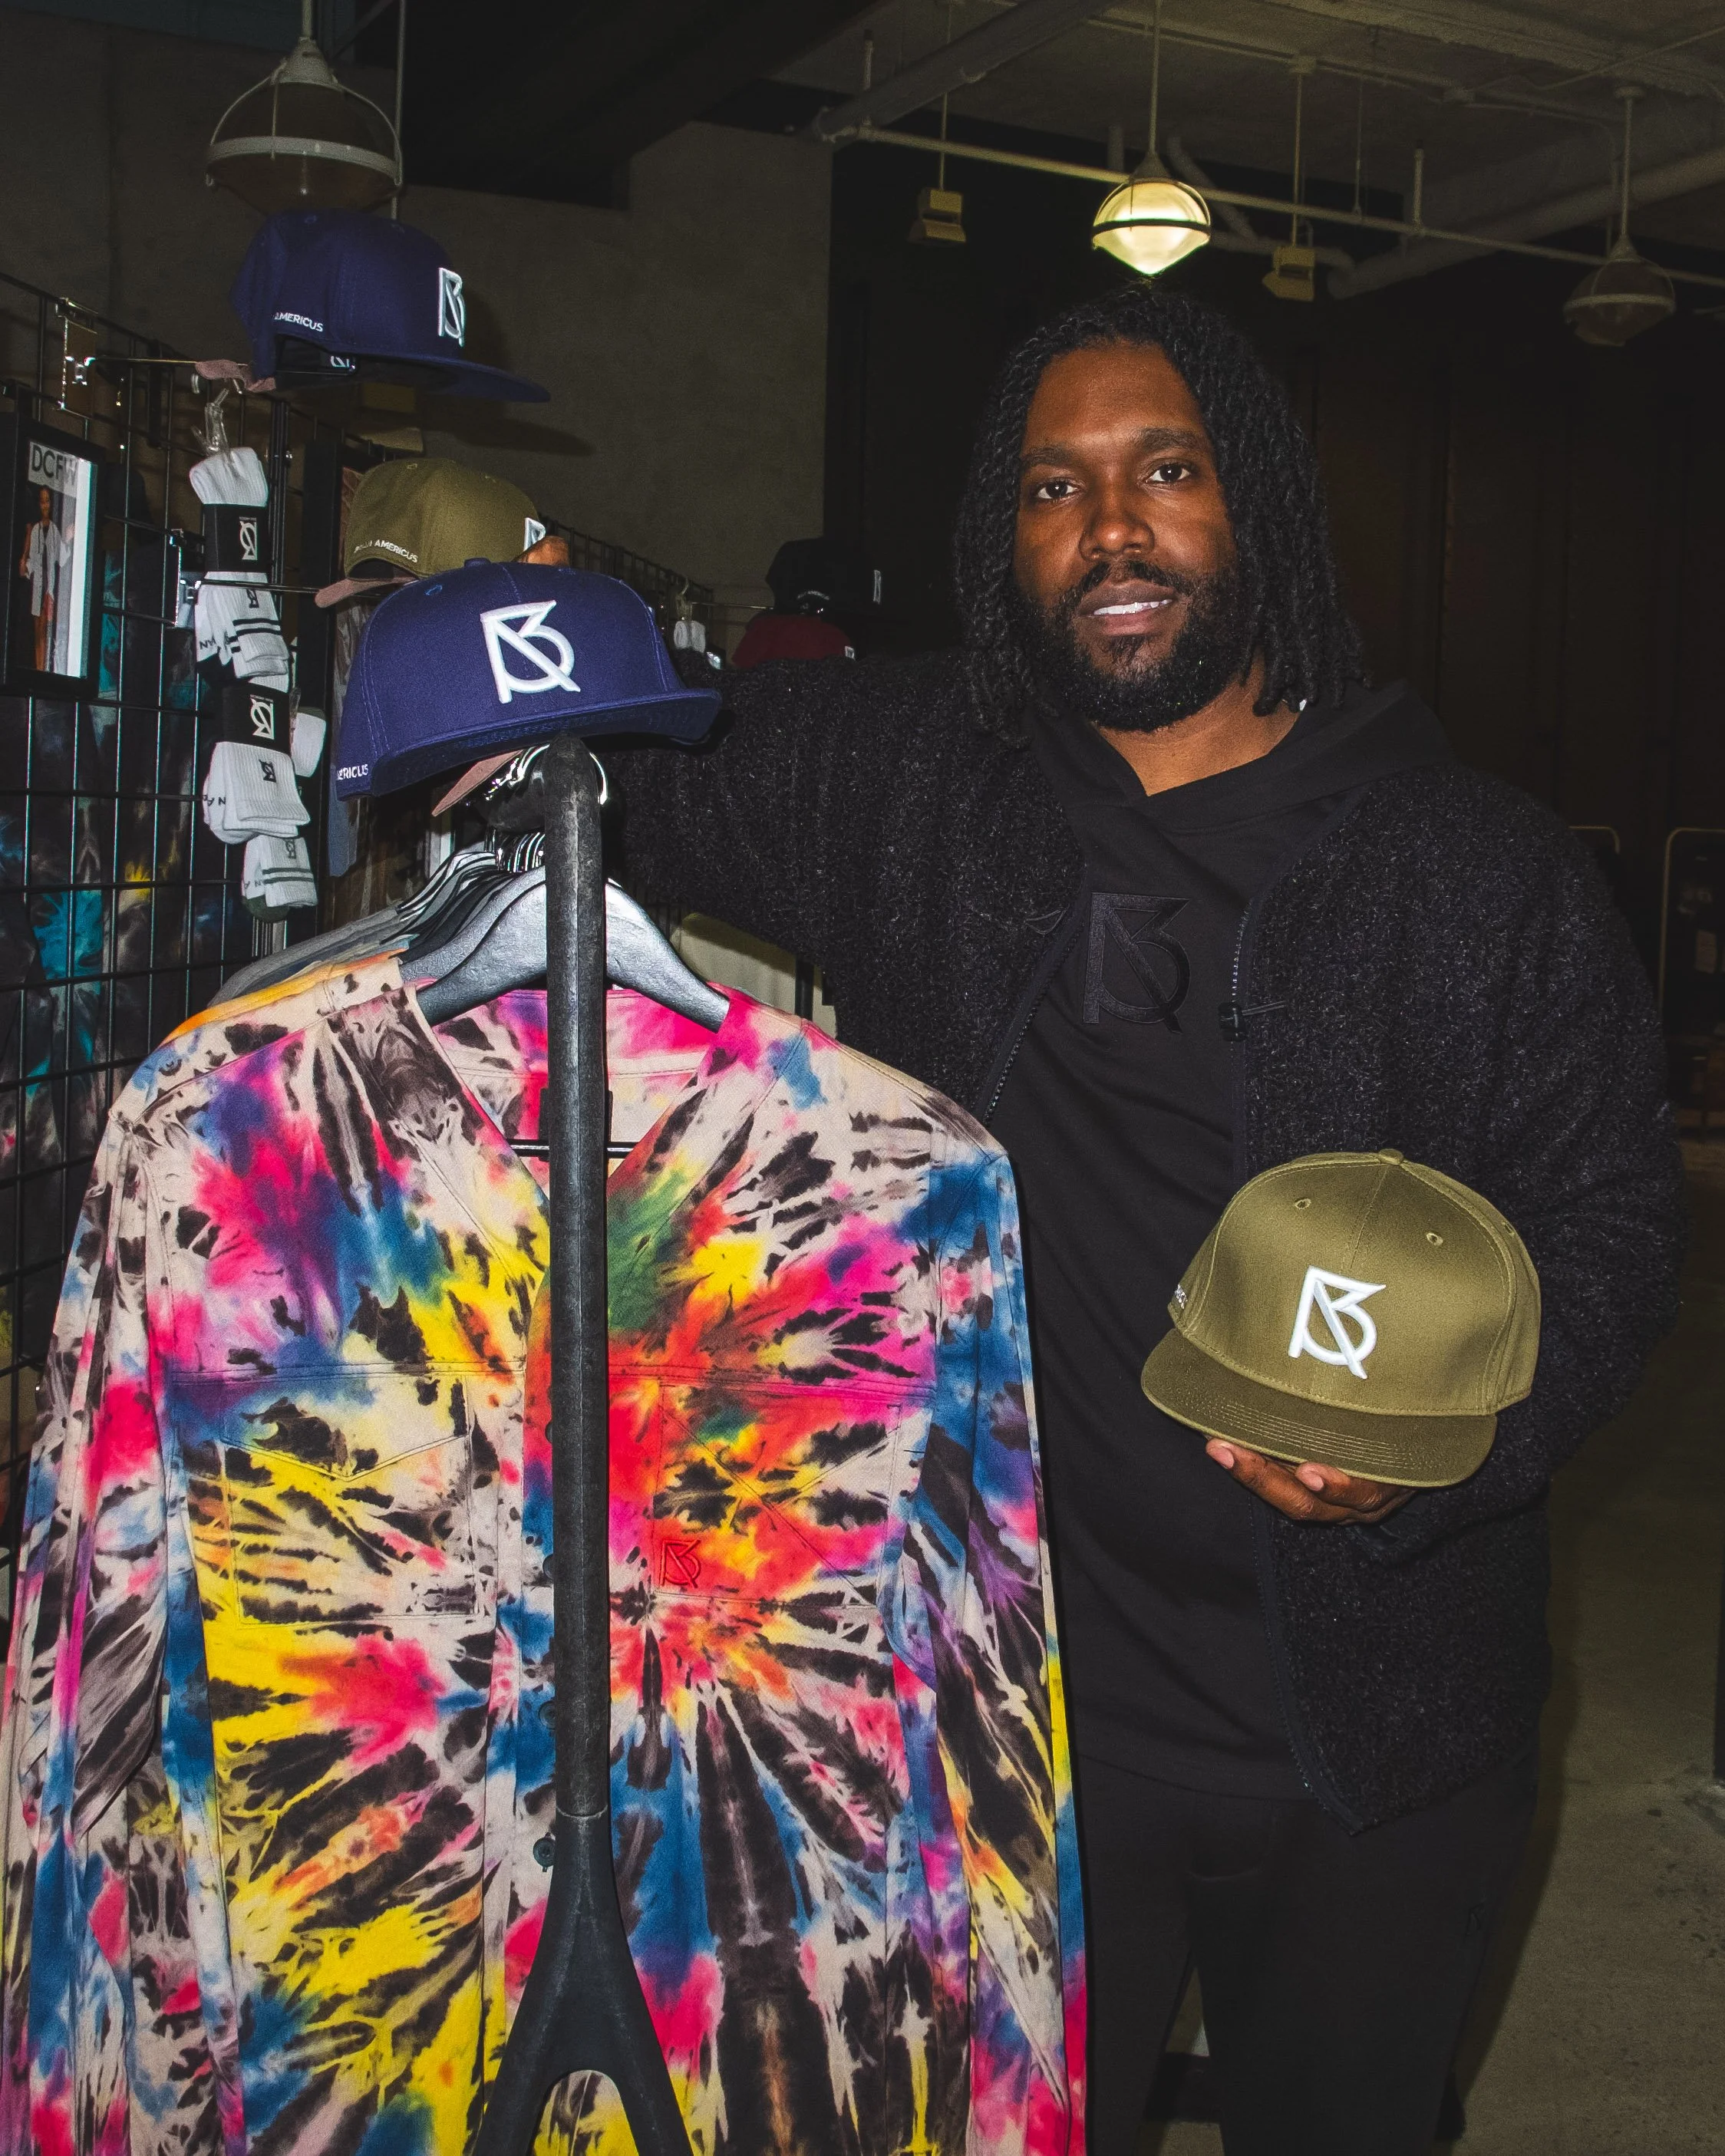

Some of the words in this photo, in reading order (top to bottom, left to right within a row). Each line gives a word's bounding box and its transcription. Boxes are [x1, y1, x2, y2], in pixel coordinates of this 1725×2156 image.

[274, 312, 324, 332] AMERICUS
[374, 539, 419, 563] AMERICUS
[337, 763, 368, 780] ERICUS
